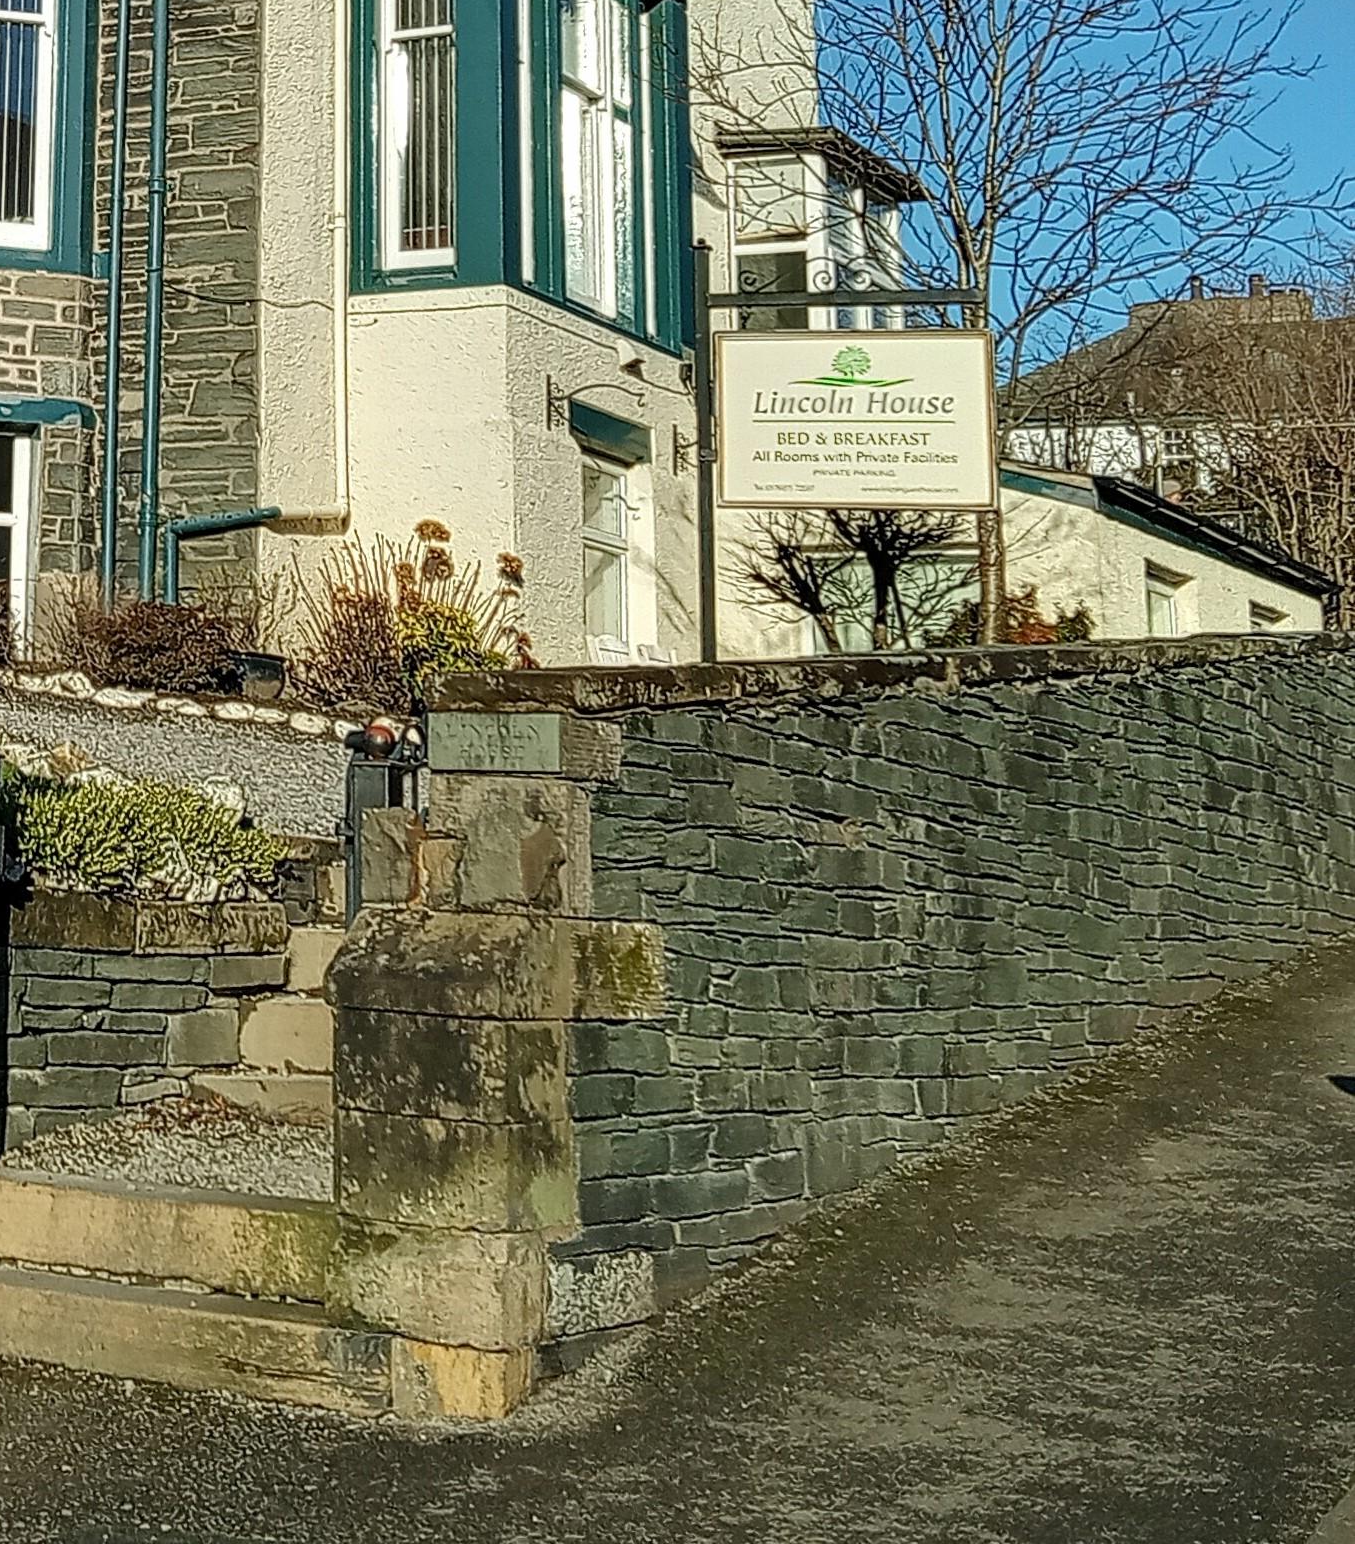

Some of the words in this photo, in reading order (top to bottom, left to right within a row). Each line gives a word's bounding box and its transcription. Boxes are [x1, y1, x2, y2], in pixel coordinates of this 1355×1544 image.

[753, 390, 853, 414] Lincoln
[867, 391, 955, 414] House
[777, 432, 810, 445] BED
[815, 432, 827, 445] &
[833, 432, 931, 446] BREAKFAST
[752, 450, 770, 462] All
[774, 450, 820, 462] Rooms
[824, 450, 852, 462] with
[856, 451, 899, 463] Private
[904, 451, 958, 464] Facilities
[853, 469, 896, 477] PARKING
